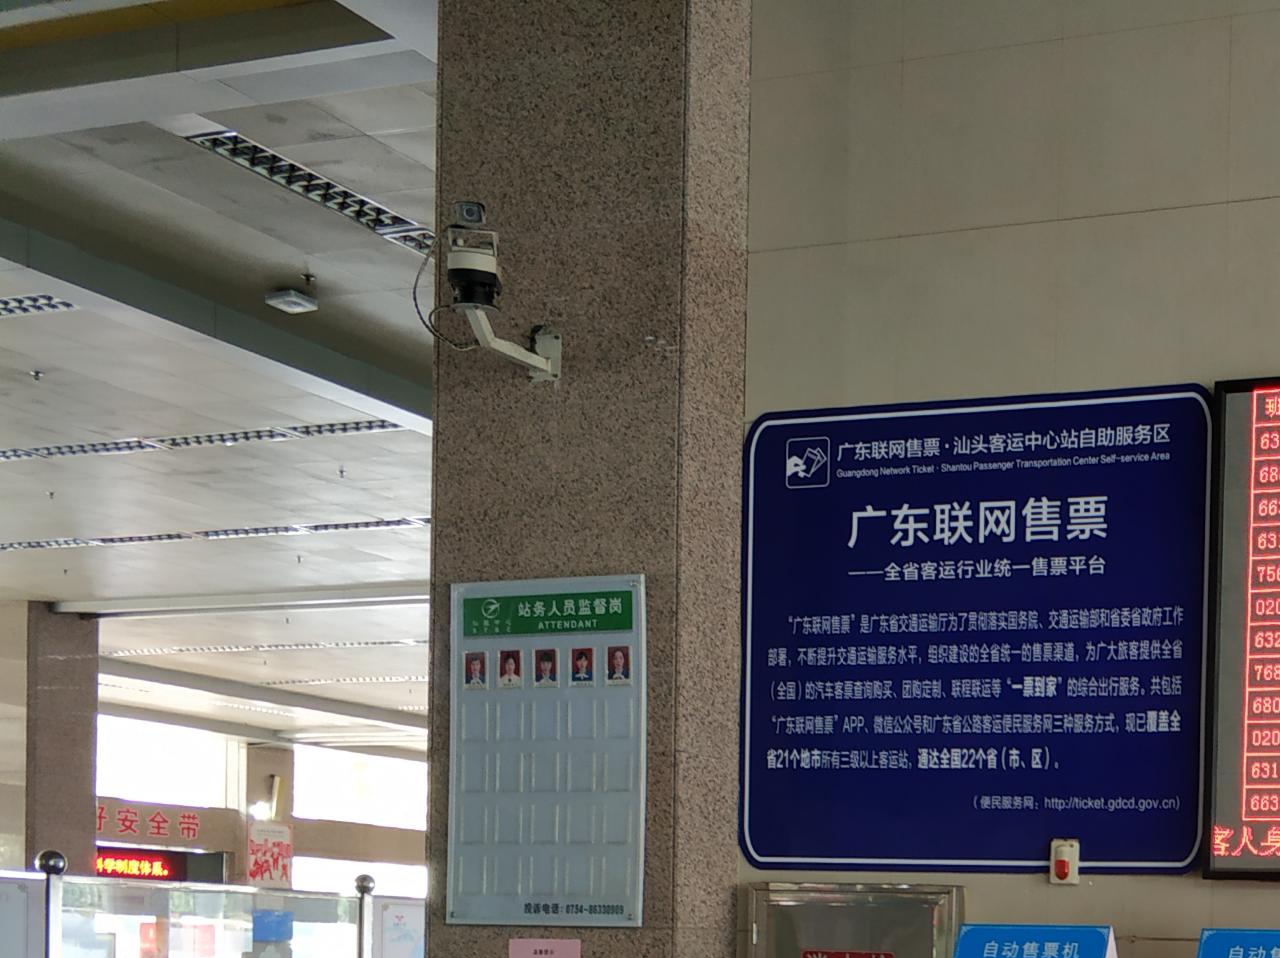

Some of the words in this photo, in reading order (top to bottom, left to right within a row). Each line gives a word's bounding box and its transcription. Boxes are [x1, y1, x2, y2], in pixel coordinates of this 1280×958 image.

[836, 468, 879, 478] Guangdong
[880, 466, 911, 476] Network
[912, 464, 935, 474] Ticket
[941, 462, 973, 473] Shantou
[973, 460, 1014, 472] Passenger
[1016, 457, 1072, 469] Transportation
[1073, 456, 1099, 466] Center
[1150, 452, 1170, 461] Area
[847, 496, 1109, 548] 广东联网售票
[518, 597, 623, 617] 站务人员监督岗
[538, 619, 599, 630] ATTENDANT
